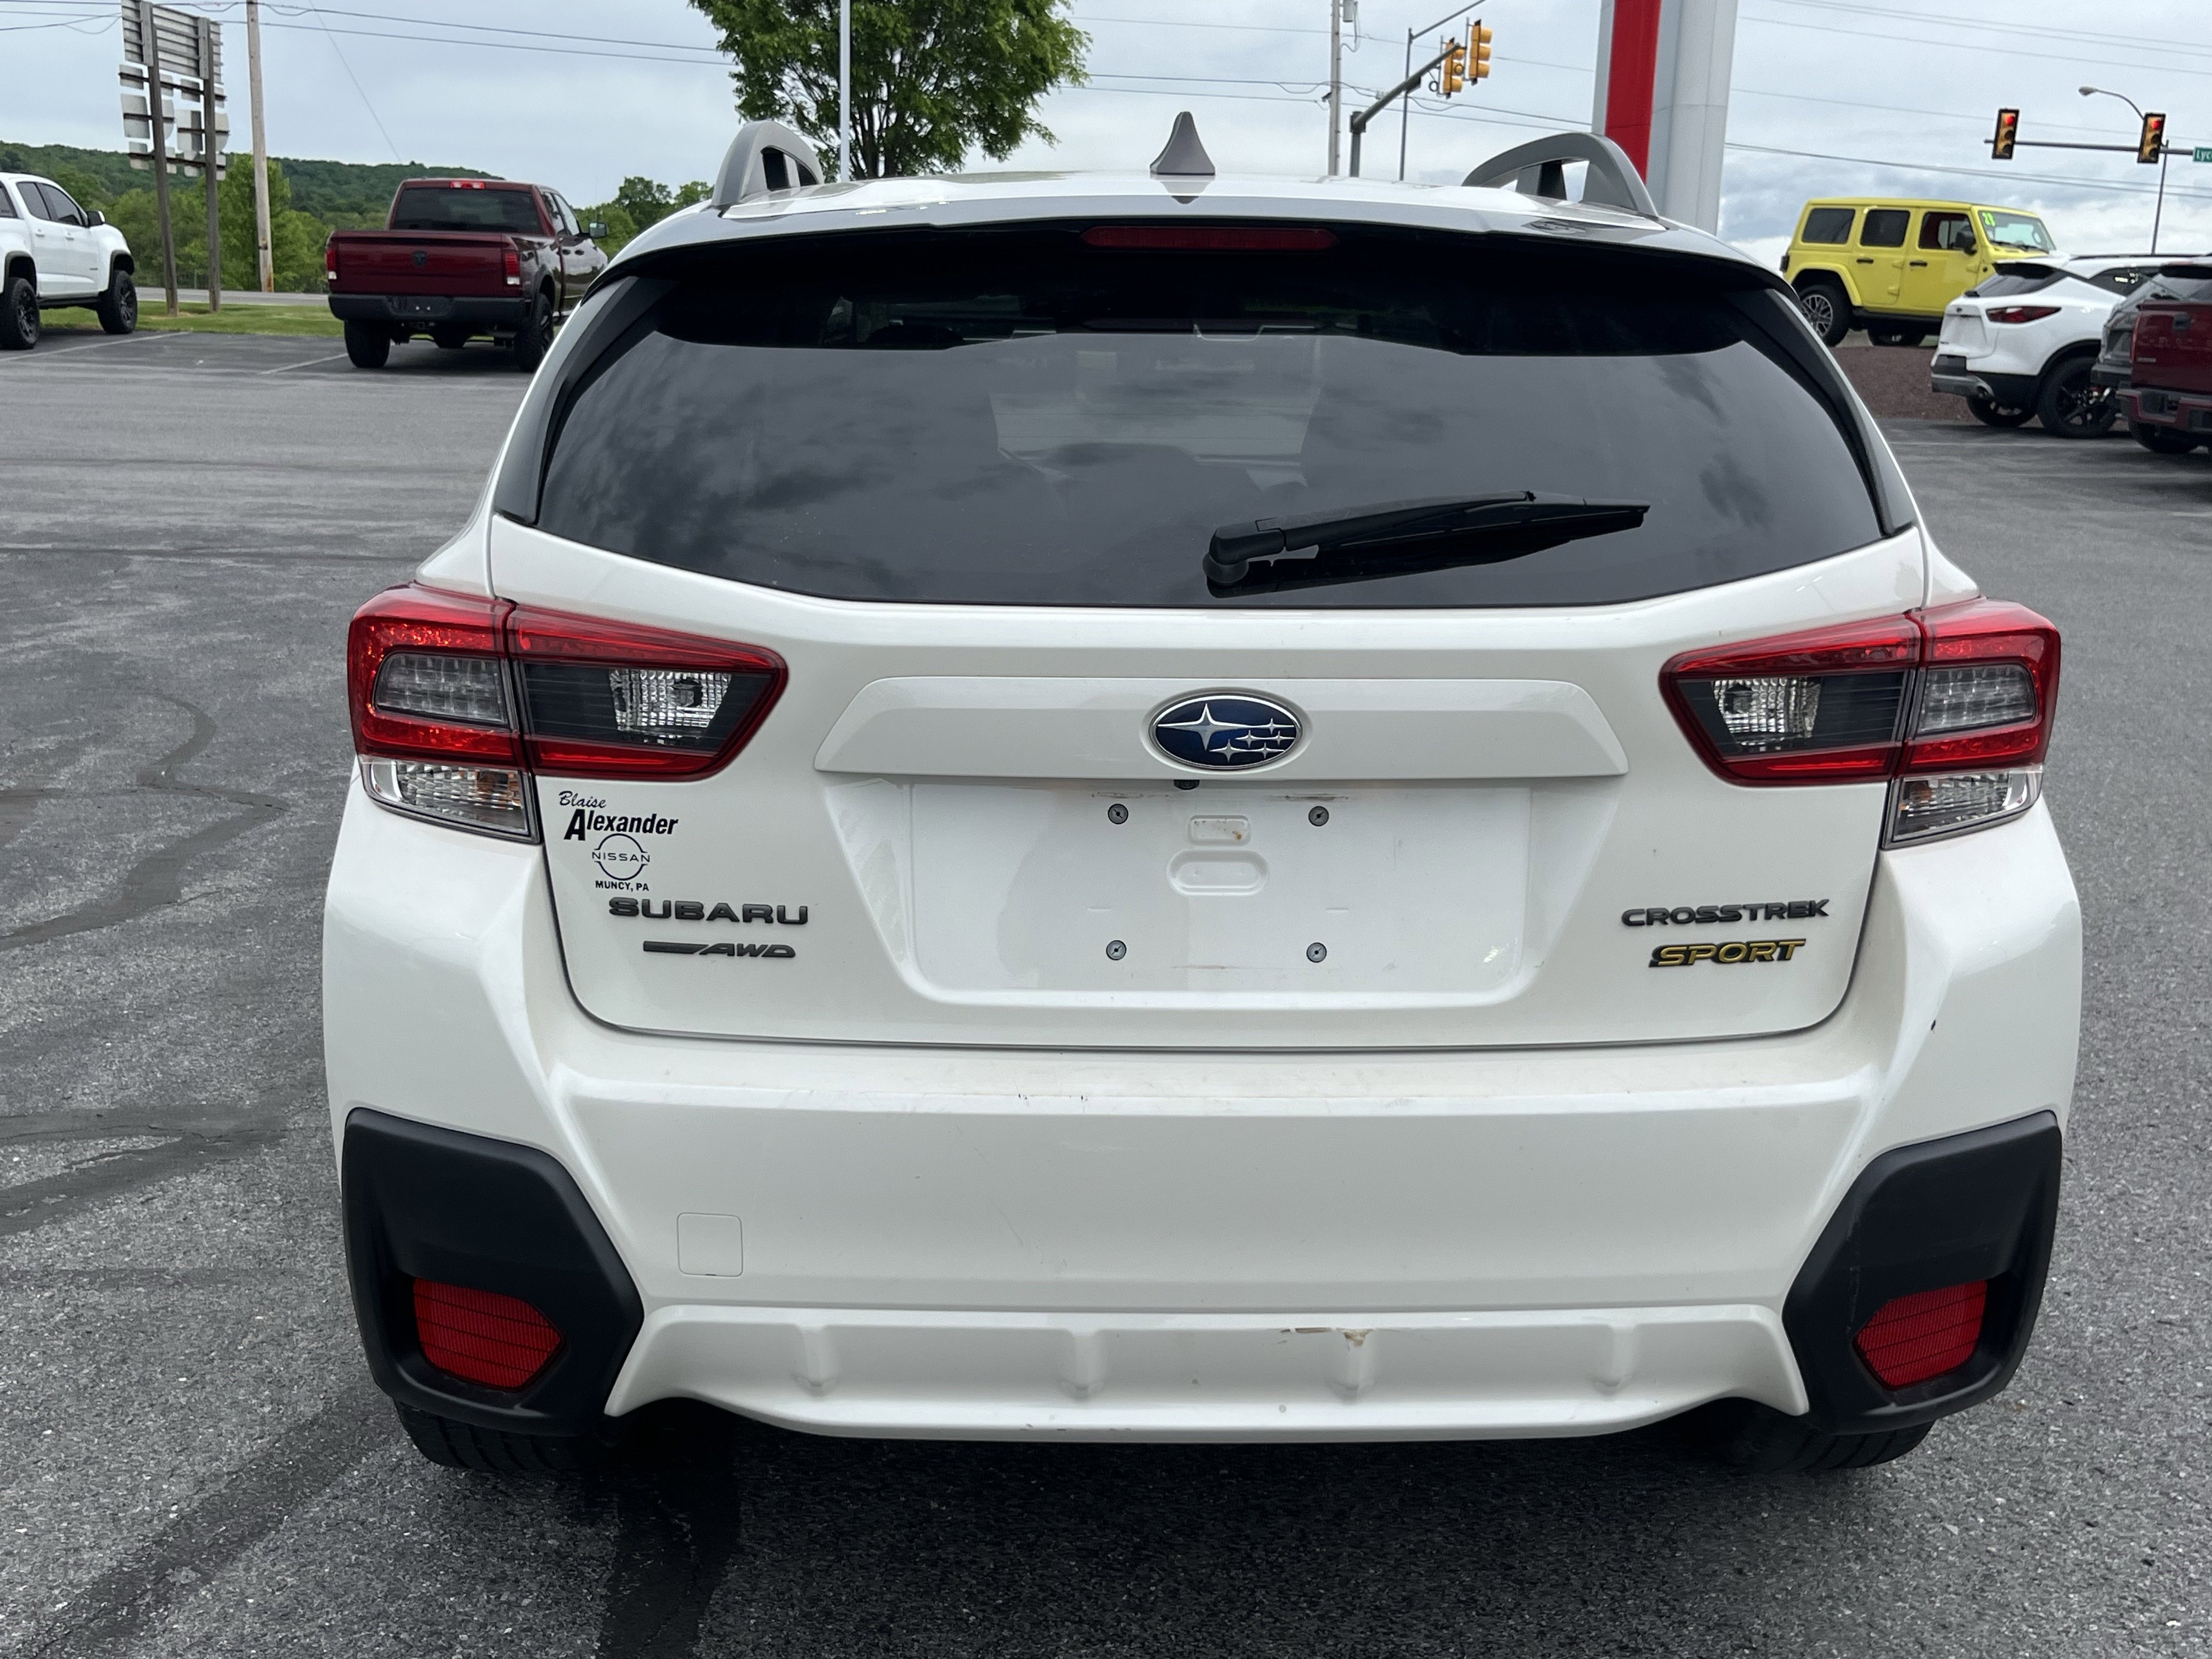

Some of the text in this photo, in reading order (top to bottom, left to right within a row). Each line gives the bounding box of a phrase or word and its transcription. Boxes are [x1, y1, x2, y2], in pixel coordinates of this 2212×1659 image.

[2196, 149, 2212, 161] Lyc
[558, 791, 607, 808] Blaise
[563, 809, 679, 841] Alexander
[592, 851, 651, 863] NISSAN
[595, 881, 650, 892] MUNCY, PA
[609, 897, 809, 925] SUBARU
[1622, 899, 1829, 926] CROSSTREK
[699, 943, 796, 958] AWD
[1649, 939, 1807, 968] SPORT
